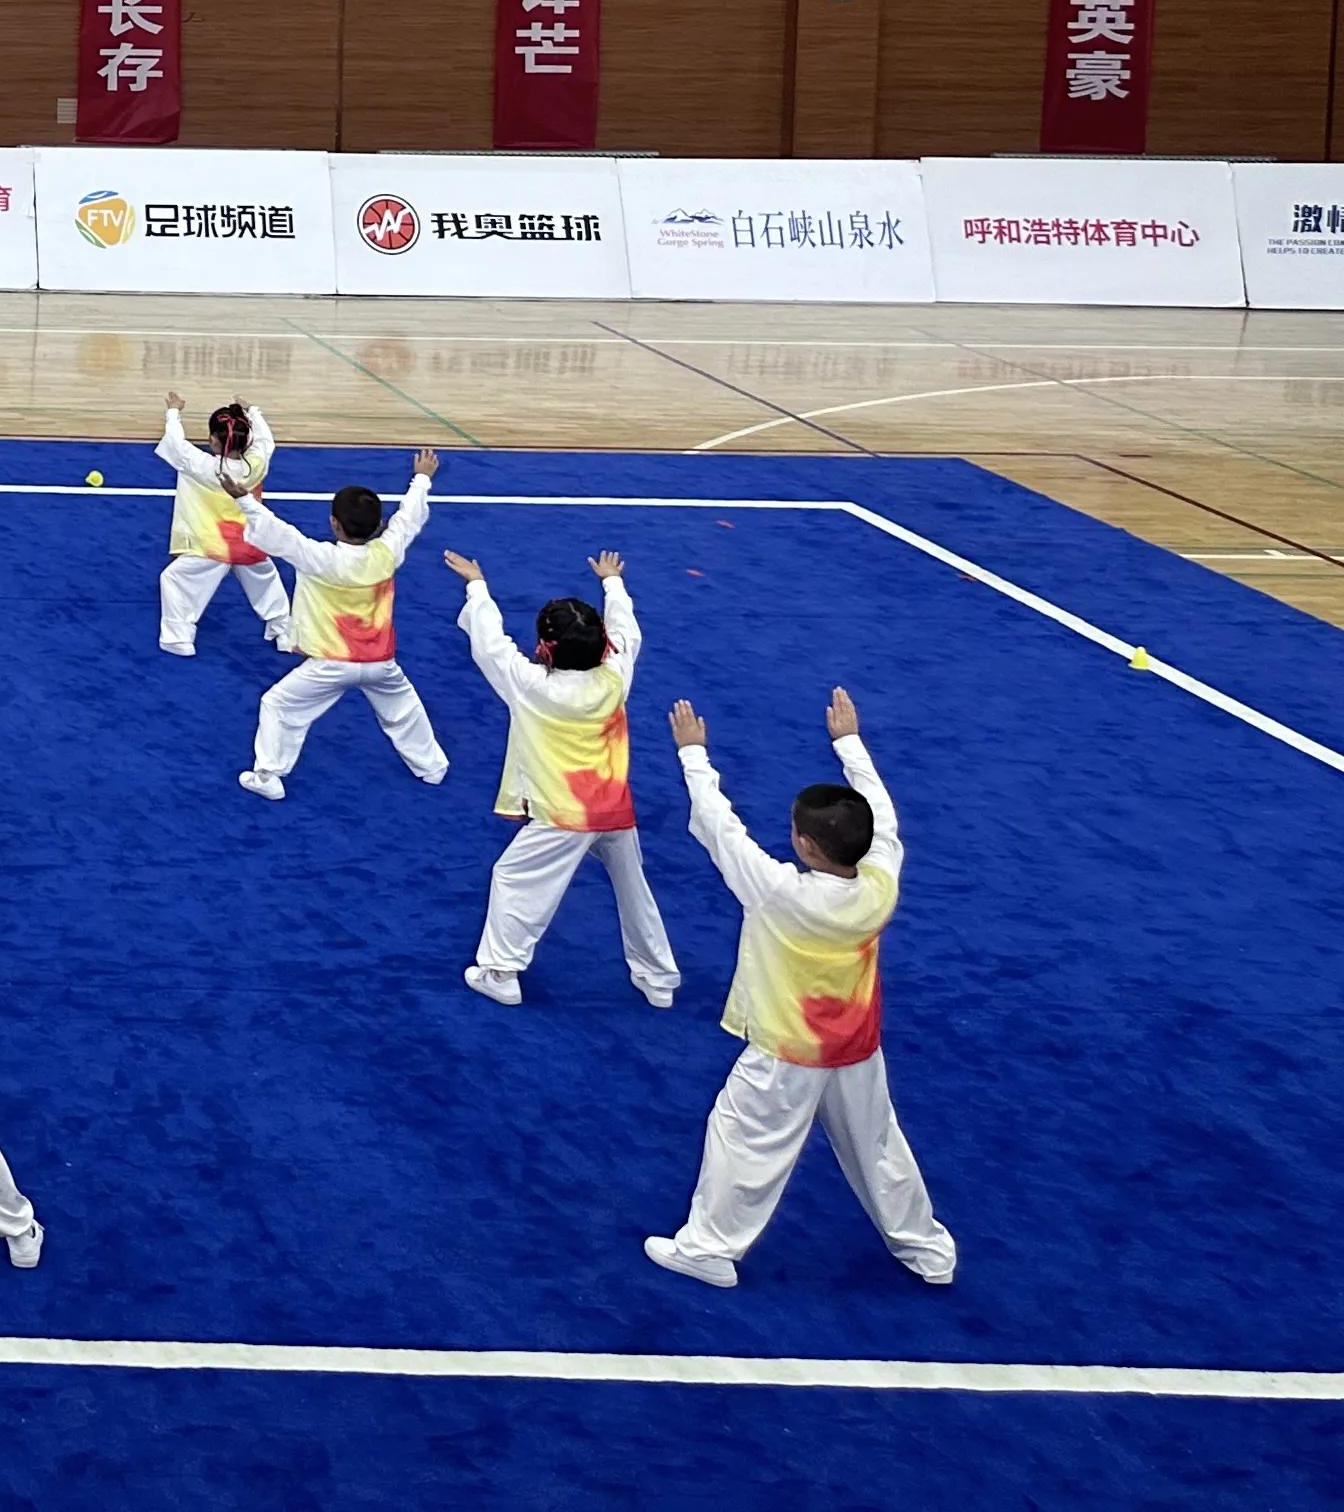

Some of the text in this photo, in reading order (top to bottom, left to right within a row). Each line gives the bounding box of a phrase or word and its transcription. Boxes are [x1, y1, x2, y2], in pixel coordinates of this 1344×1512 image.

[87, 209, 124, 227] FTV
[145, 204, 296, 239] 足球频道
[430, 213, 602, 241] 我奥篮球
[731, 209, 905, 249] 白石峡山泉水
[963, 217, 1201, 247] 呼和浩特体育中心
